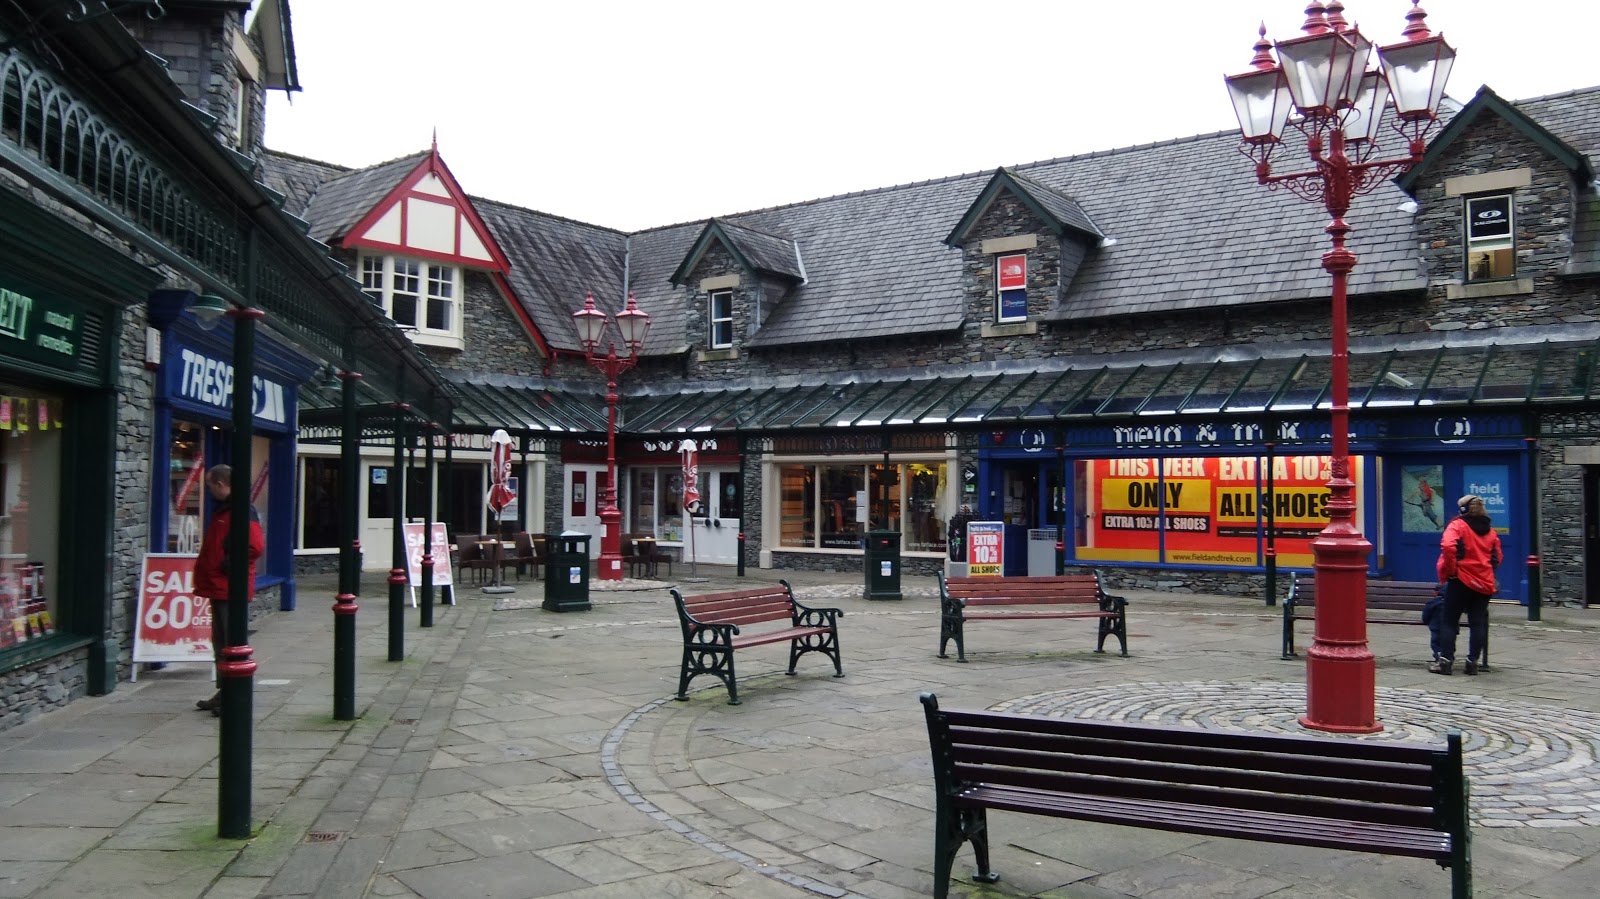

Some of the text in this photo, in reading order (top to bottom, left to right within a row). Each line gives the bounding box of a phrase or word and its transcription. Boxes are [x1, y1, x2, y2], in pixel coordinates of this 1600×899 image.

[1108, 457, 1205, 477] THIS WEEK
[1219, 456, 1288, 481] EXTRA
[1469, 483, 1500, 494] field
[1220, 493, 1255, 517] ALL
[1105, 516, 1134, 529] EXTRA
[1173, 517, 1207, 531] SHOES
[973, 534, 998, 546] EXTRA
[1172, 552, 1252, 564] www.fieldandtrek.com
[970, 566, 1000, 574] ALL SHOES
[145, 570, 195, 594] SAL
